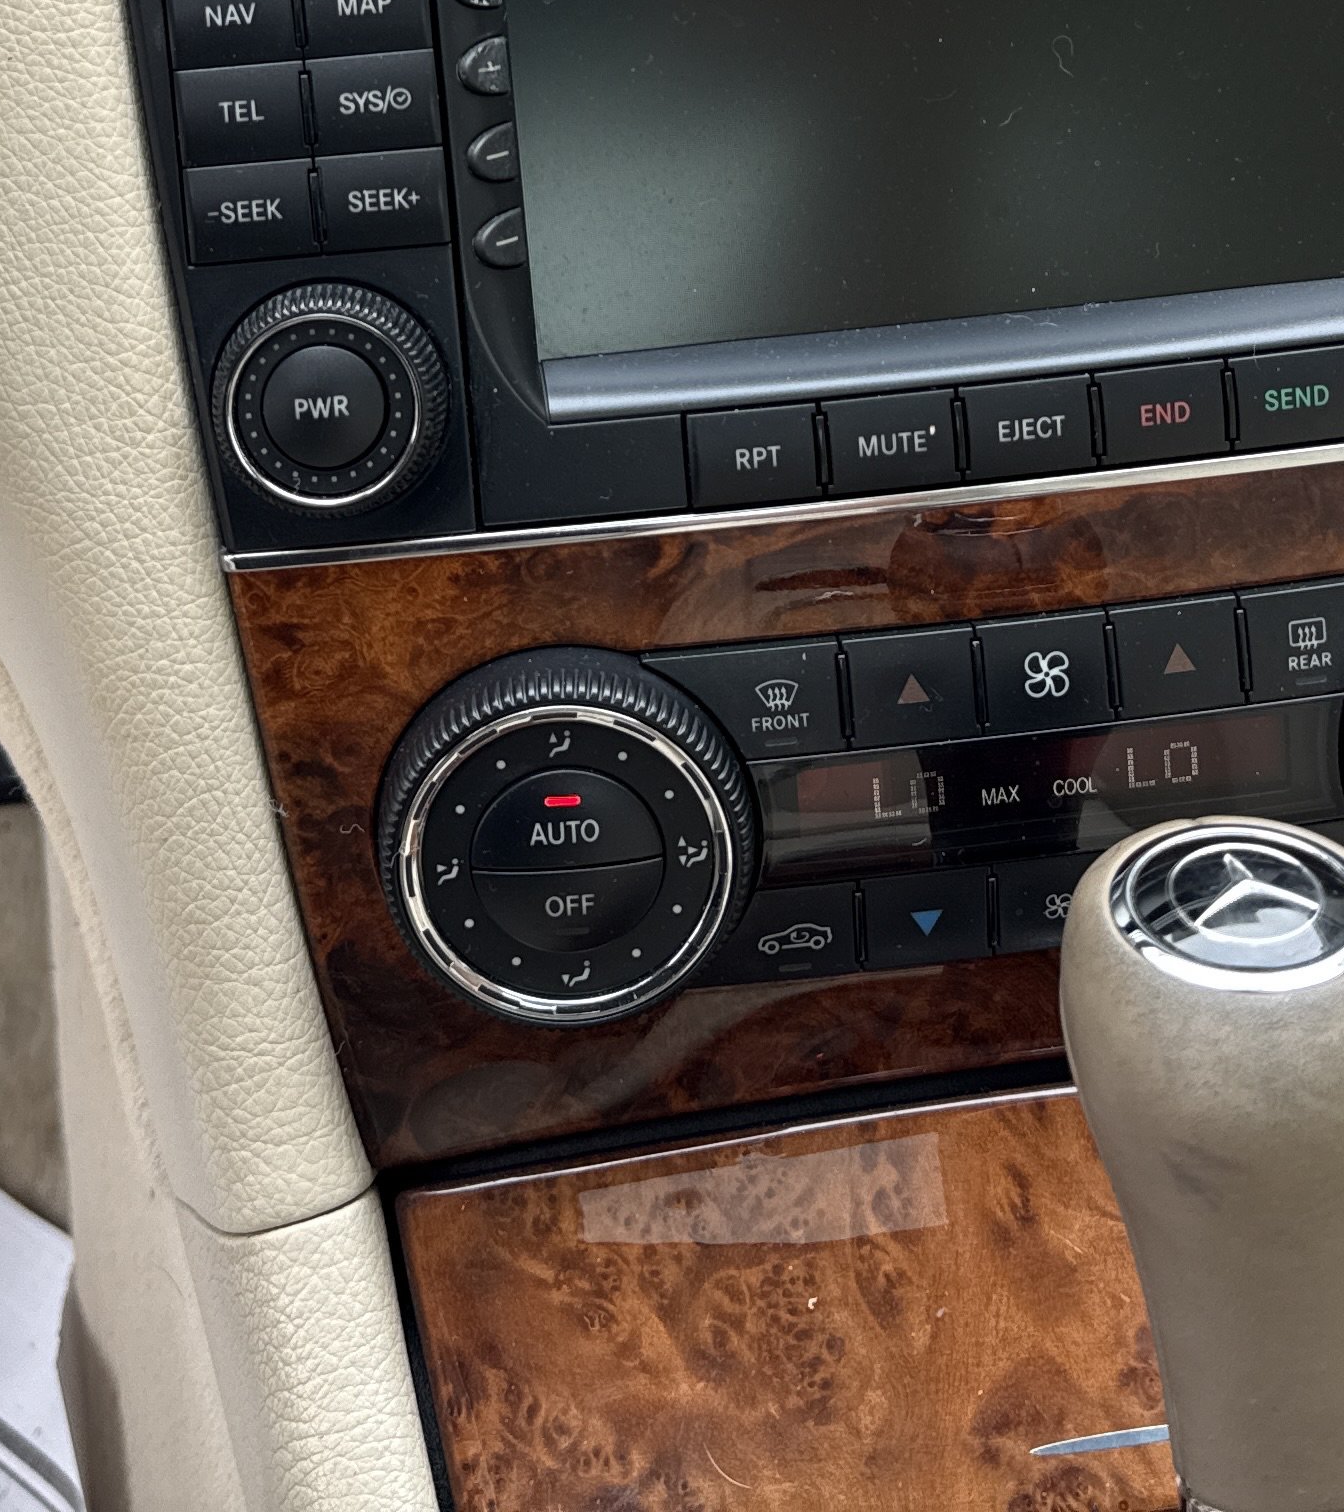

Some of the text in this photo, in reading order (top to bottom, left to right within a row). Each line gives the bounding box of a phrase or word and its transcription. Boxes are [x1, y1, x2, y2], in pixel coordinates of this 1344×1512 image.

[203, 2, 256, 28] NAV
[218, 99, 265, 123] TEL
[347, 188, 421, 214] SEEK+
[294, 395, 350, 420] PWR
[1263, 384, 1330, 412] SEND
[1139, 401, 1192, 428] END
[997, 415, 1066, 443] EJECT
[858, 431, 929, 458] MUTE
[734, 445, 782, 471] RPT
[1287, 651, 1334, 671] REAR
[751, 712, 811, 733] FRONT
[981, 775, 1098, 806] MAX COOL
[529, 818, 600, 846] AUTO
[545, 893, 595, 918] OFF
